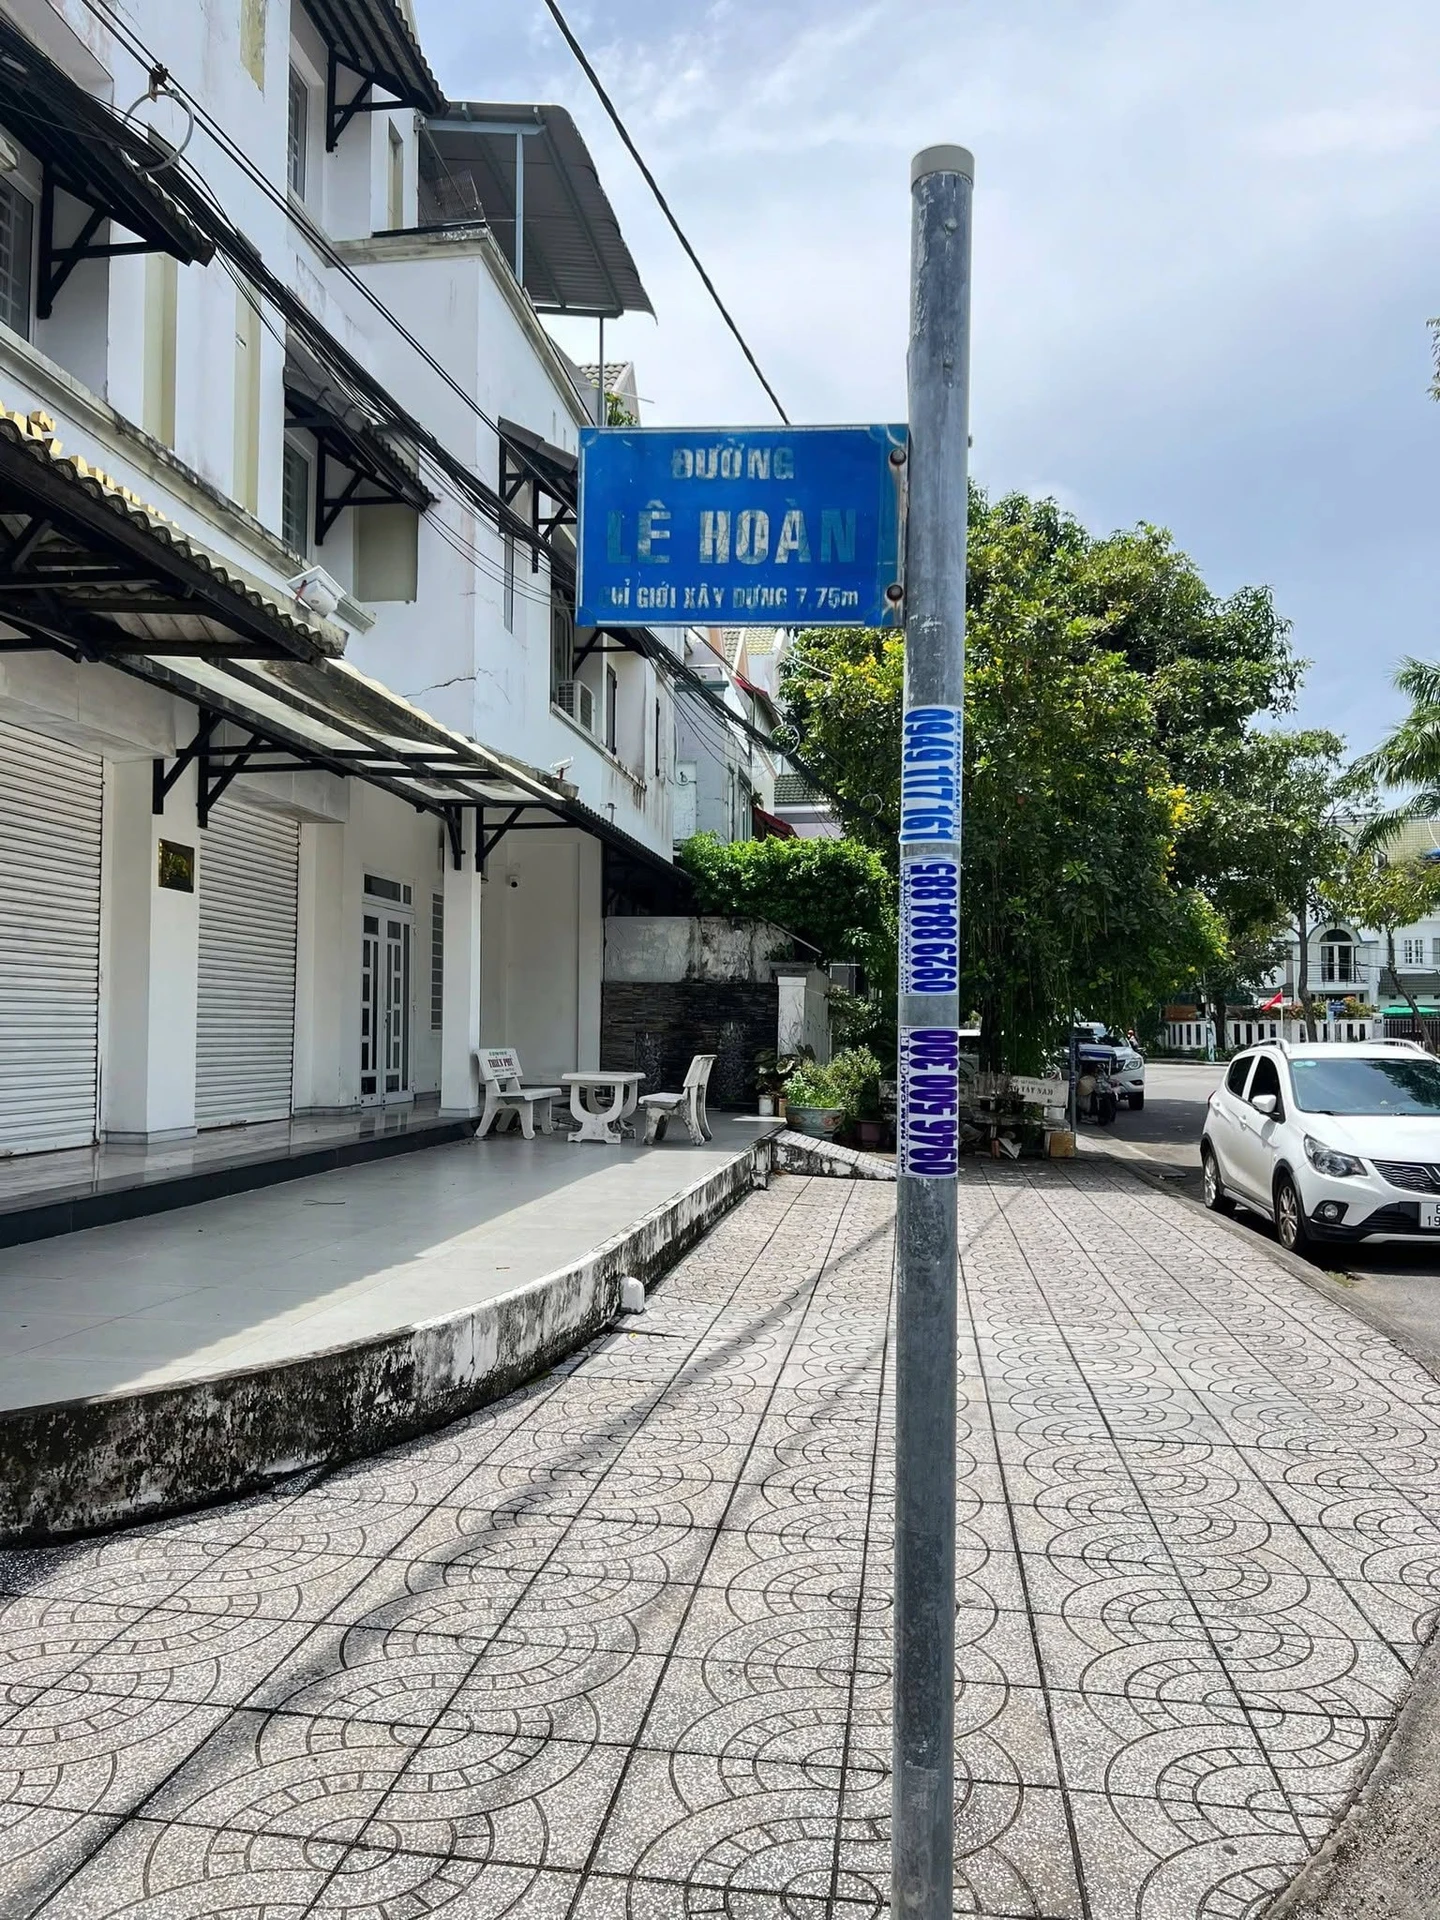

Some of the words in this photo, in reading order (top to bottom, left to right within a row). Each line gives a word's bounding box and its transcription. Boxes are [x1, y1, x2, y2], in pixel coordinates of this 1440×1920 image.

[671, 437, 795, 480] ĐƯỜNG
[606, 498, 672, 565] LÊ
[698, 497, 857, 565] HOÀN
[636, 580, 676, 609] GIỚI
[684, 582, 724, 609] XÂY
[908, 1030, 958, 1071] 300
[908, 1075, 958, 1116] 500
[908, 1120, 957, 1175] 0946
